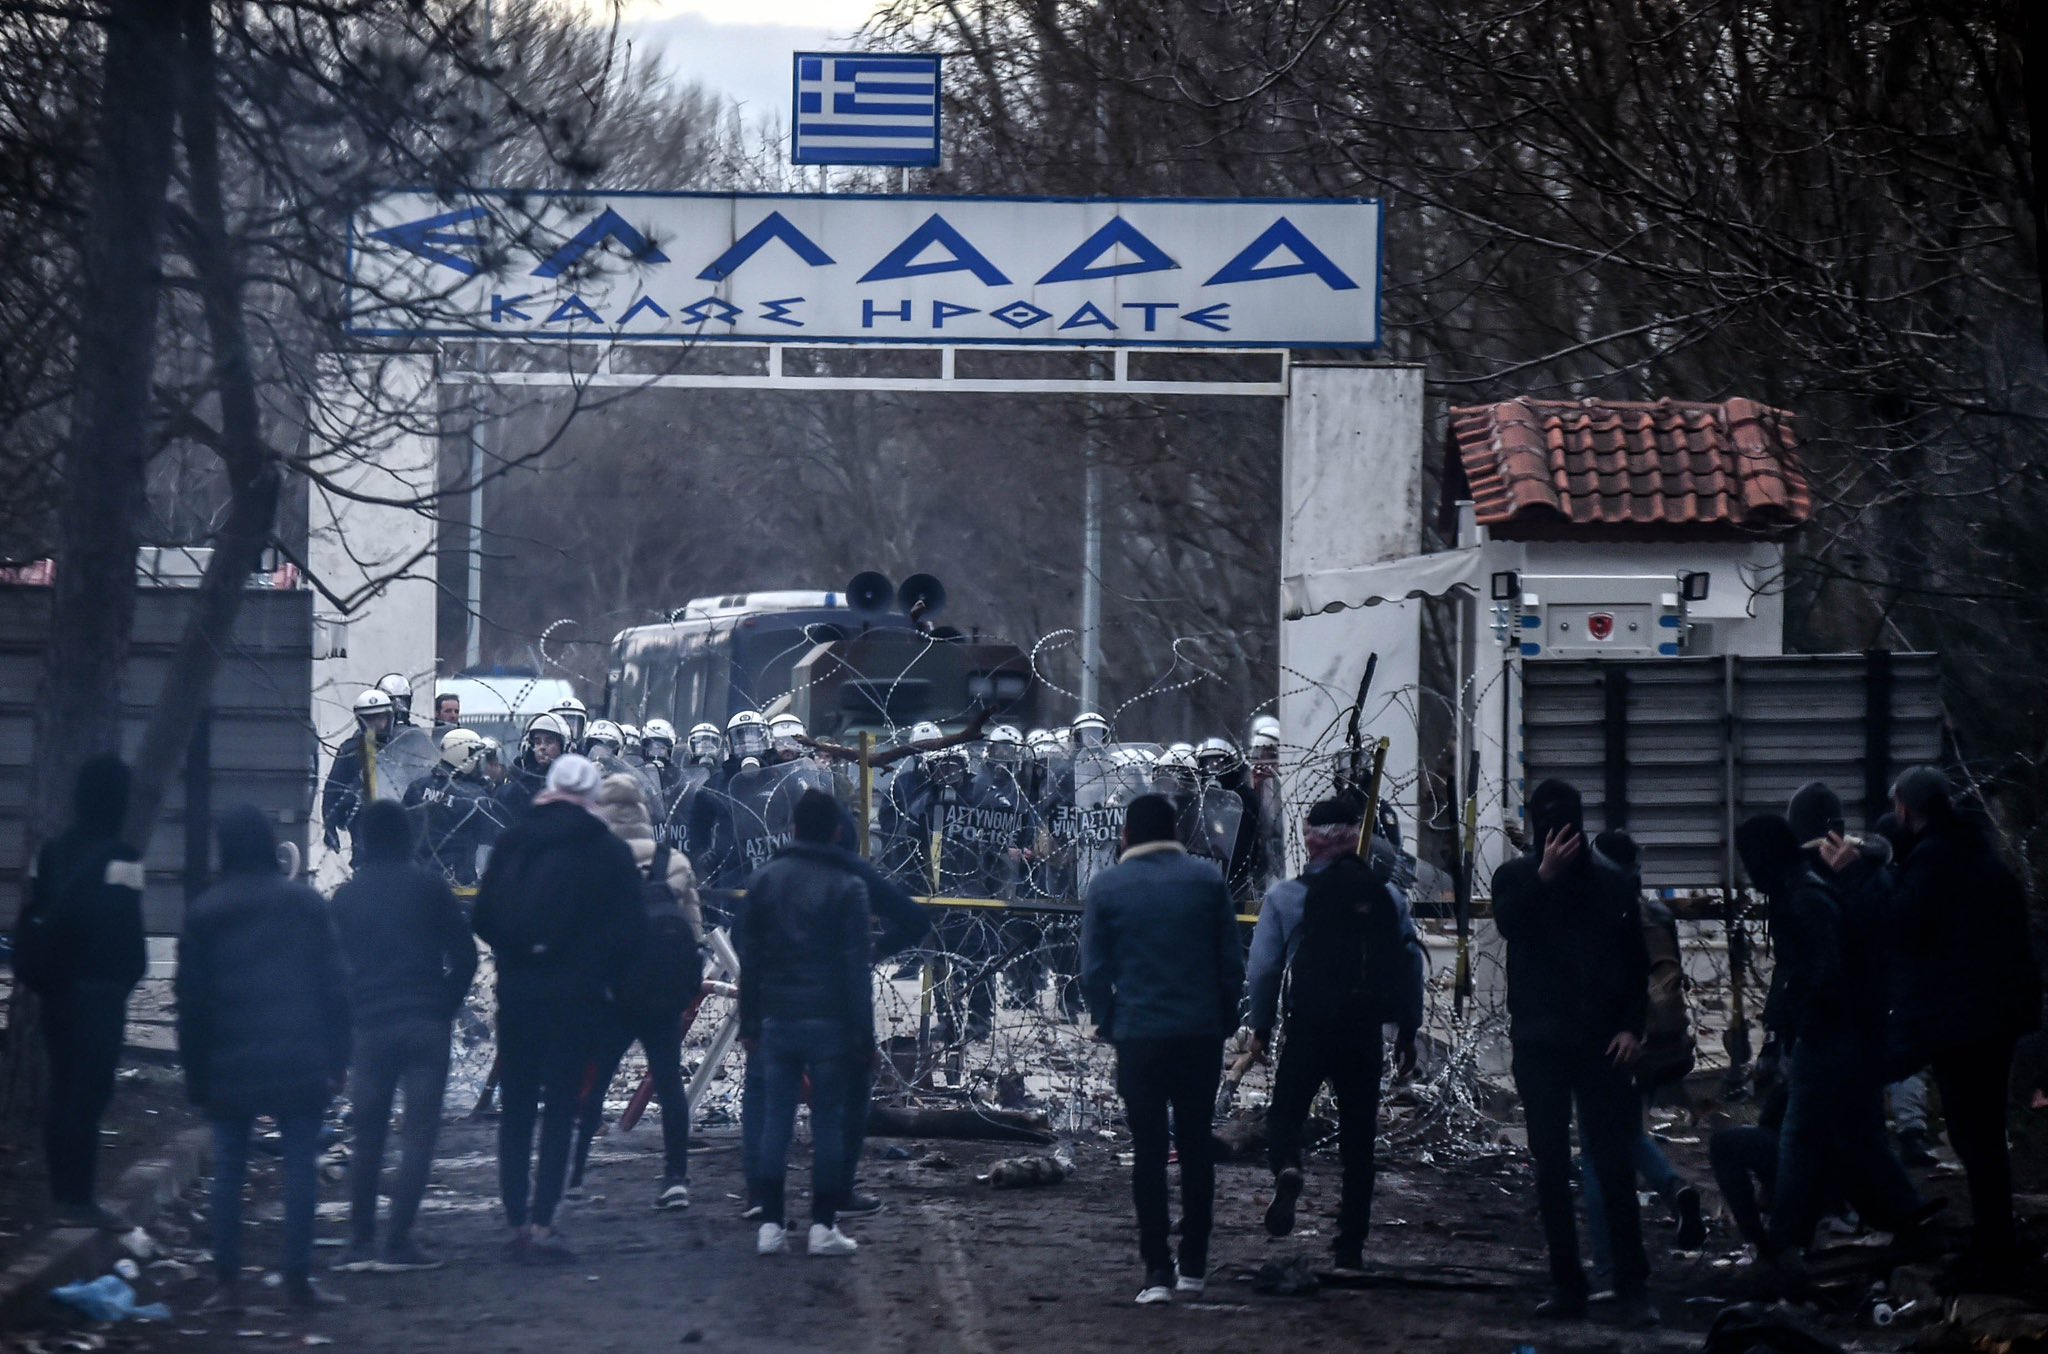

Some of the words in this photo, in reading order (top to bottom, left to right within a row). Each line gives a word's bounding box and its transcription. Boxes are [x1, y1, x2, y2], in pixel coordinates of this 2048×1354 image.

[366, 205, 1360, 290] ΕΛΛΑΔΑ
[490, 294, 805, 327] ΚΑΛΩΣ
[861, 300, 1232, 332] ΗΡΘΑΤΕ
[1081, 807, 1128, 830] ΑΣΤΥΝ
[746, 831, 793, 858] ΑΣΤΥΝ
